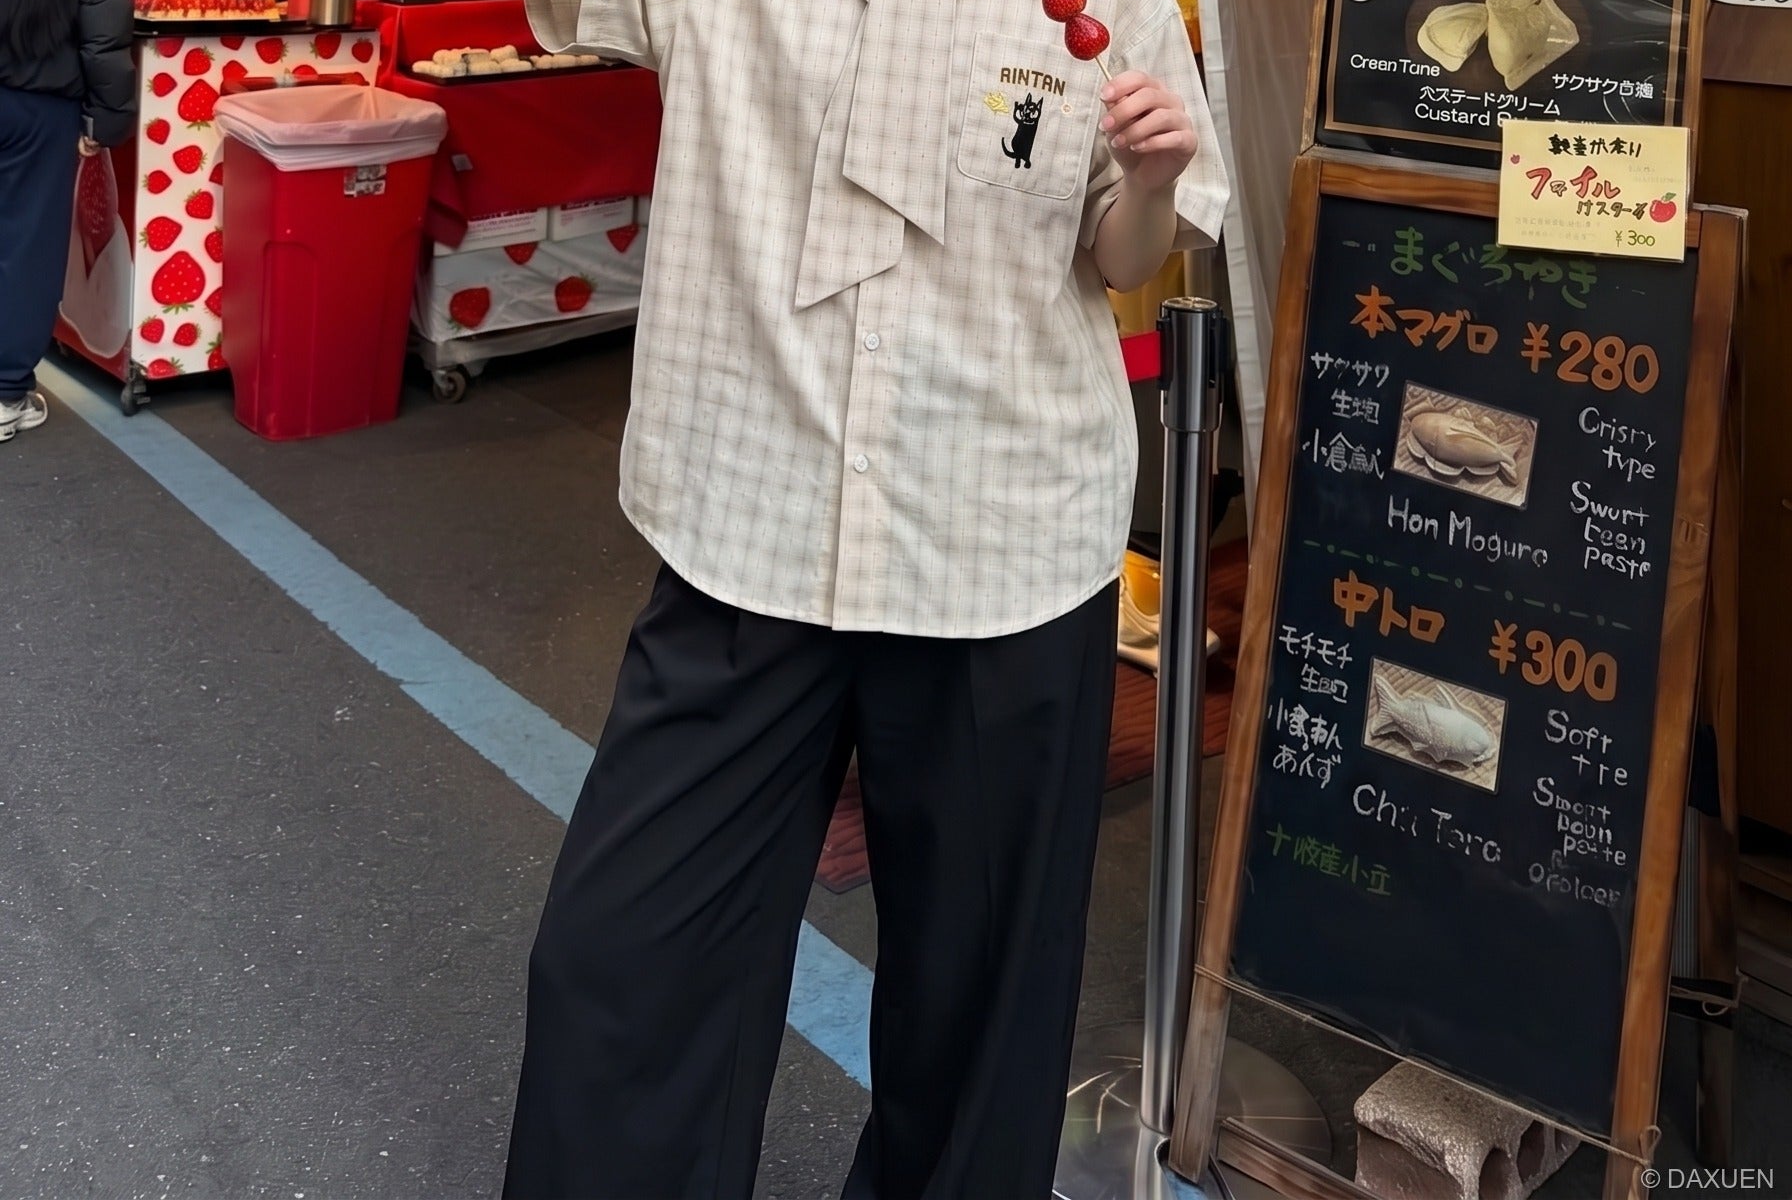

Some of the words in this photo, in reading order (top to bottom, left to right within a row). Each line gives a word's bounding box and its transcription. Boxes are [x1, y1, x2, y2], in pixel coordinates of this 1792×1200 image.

[1414, 103, 1491, 127] Custard
[1350, 284, 1499, 354] 本マグロ
[1520, 321, 1660, 394] ¥280
[1388, 495, 1439, 541] Hon
[1333, 570, 1446, 643] 中トロ
[1488, 618, 1619, 702] ¥300
